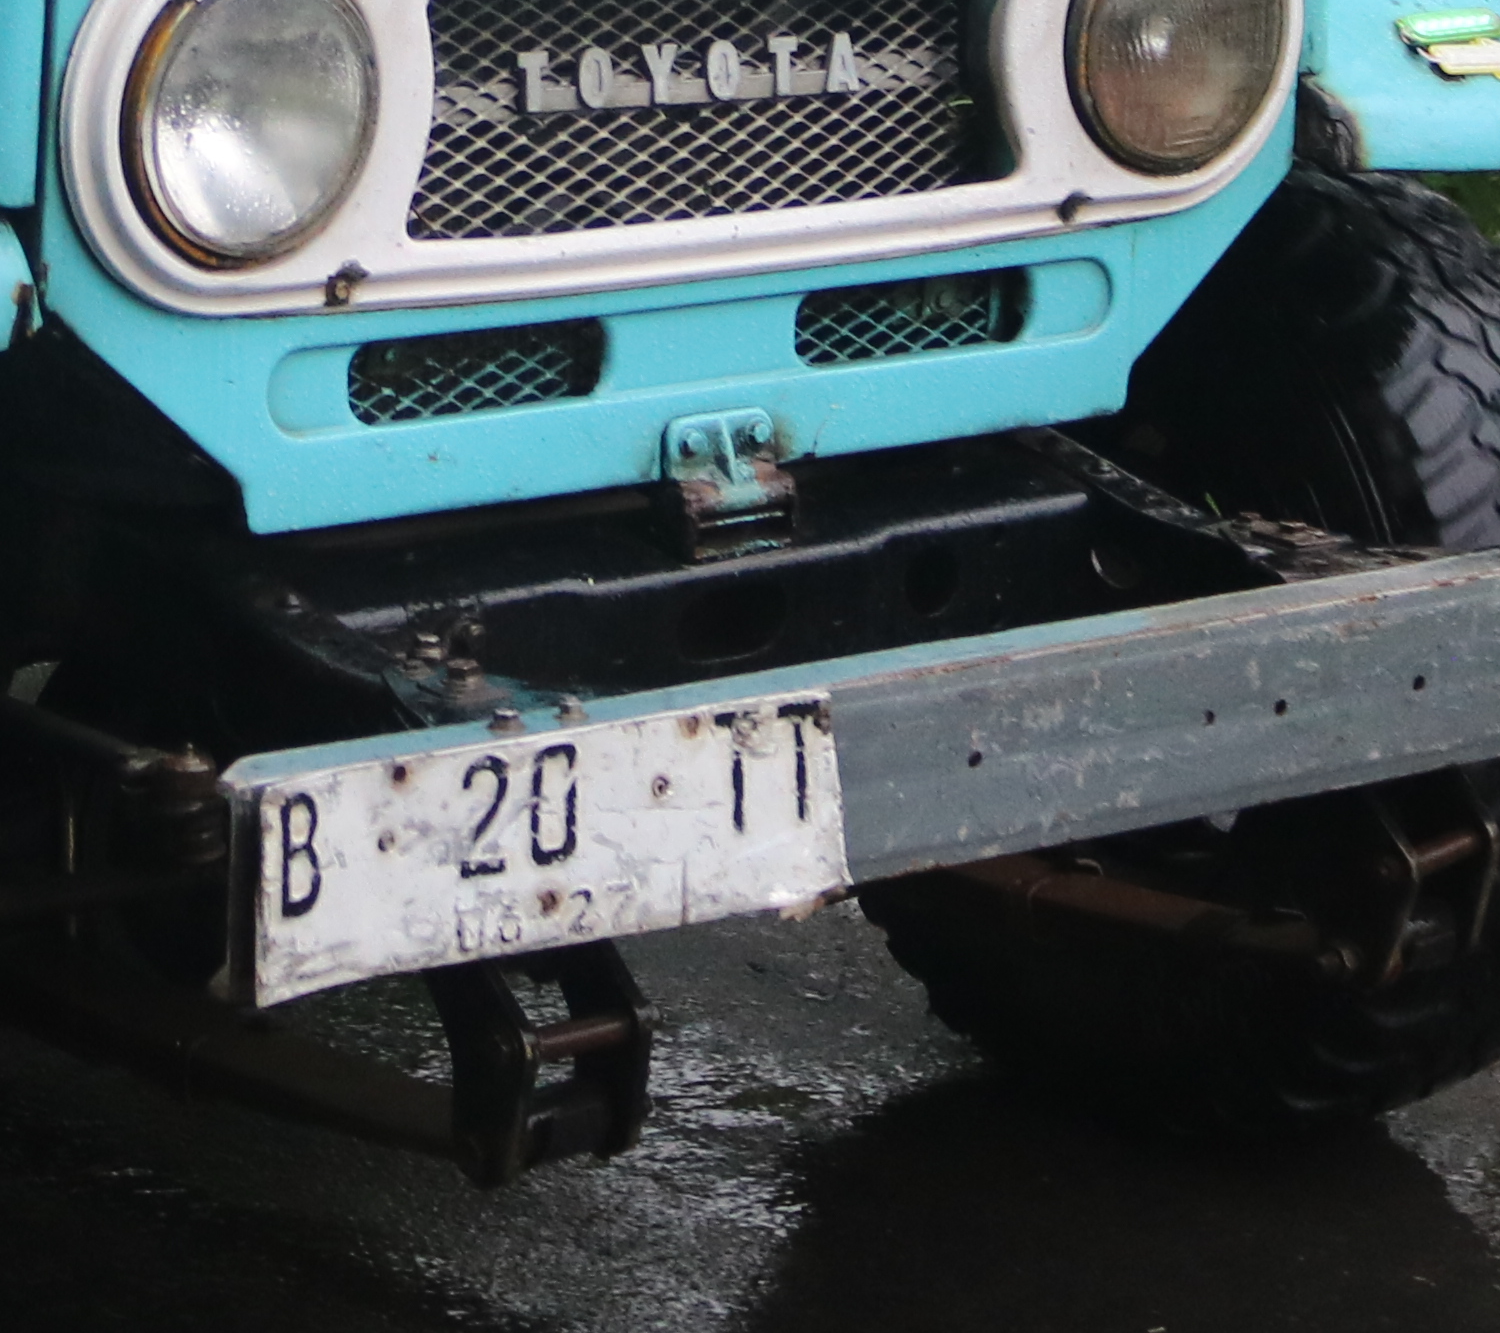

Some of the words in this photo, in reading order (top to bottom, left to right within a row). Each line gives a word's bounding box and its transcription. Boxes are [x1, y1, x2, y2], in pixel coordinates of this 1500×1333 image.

[515, 31, 862, 114] TOYOTA
[280, 791, 321, 920] B
[459, 743, 579, 879] 20
